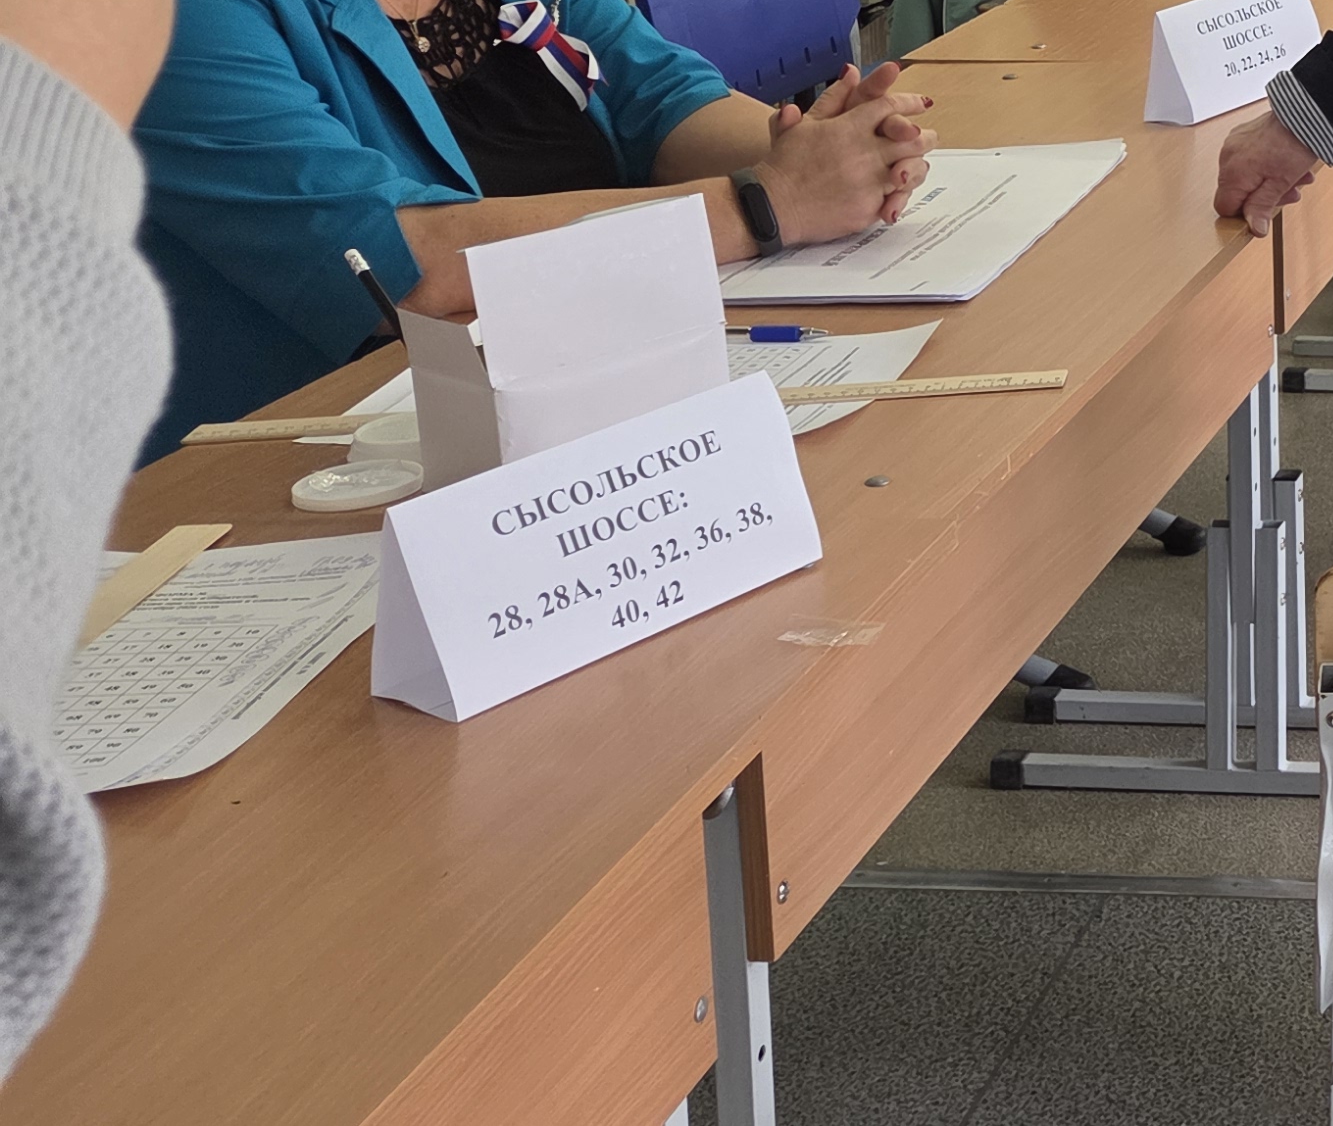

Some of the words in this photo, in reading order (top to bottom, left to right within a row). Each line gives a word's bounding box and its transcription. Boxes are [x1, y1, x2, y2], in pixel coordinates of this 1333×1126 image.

[1222, 23, 1274, 50] ШОССЕ:
[1224, 61, 1241, 77] 20,
[1241, 55, 1257, 71] 22,
[1257, 49, 1274, 65] 24,
[1274, 43, 1287, 59] 26
[491, 429, 722, 536] СЫСОЛЬСКОЕ
[555, 489, 689, 558] ШОССЕ:
[487, 605, 533, 639] 28,
[537, 577, 603, 618] 28А,
[606, 556, 648, 589] 30,
[650, 537, 690, 569] 32,
[694, 517, 733, 551] 36,
[735, 502, 774, 533] 38,
[611, 599, 650, 629] 40,
[655, 579, 685, 609] 42
